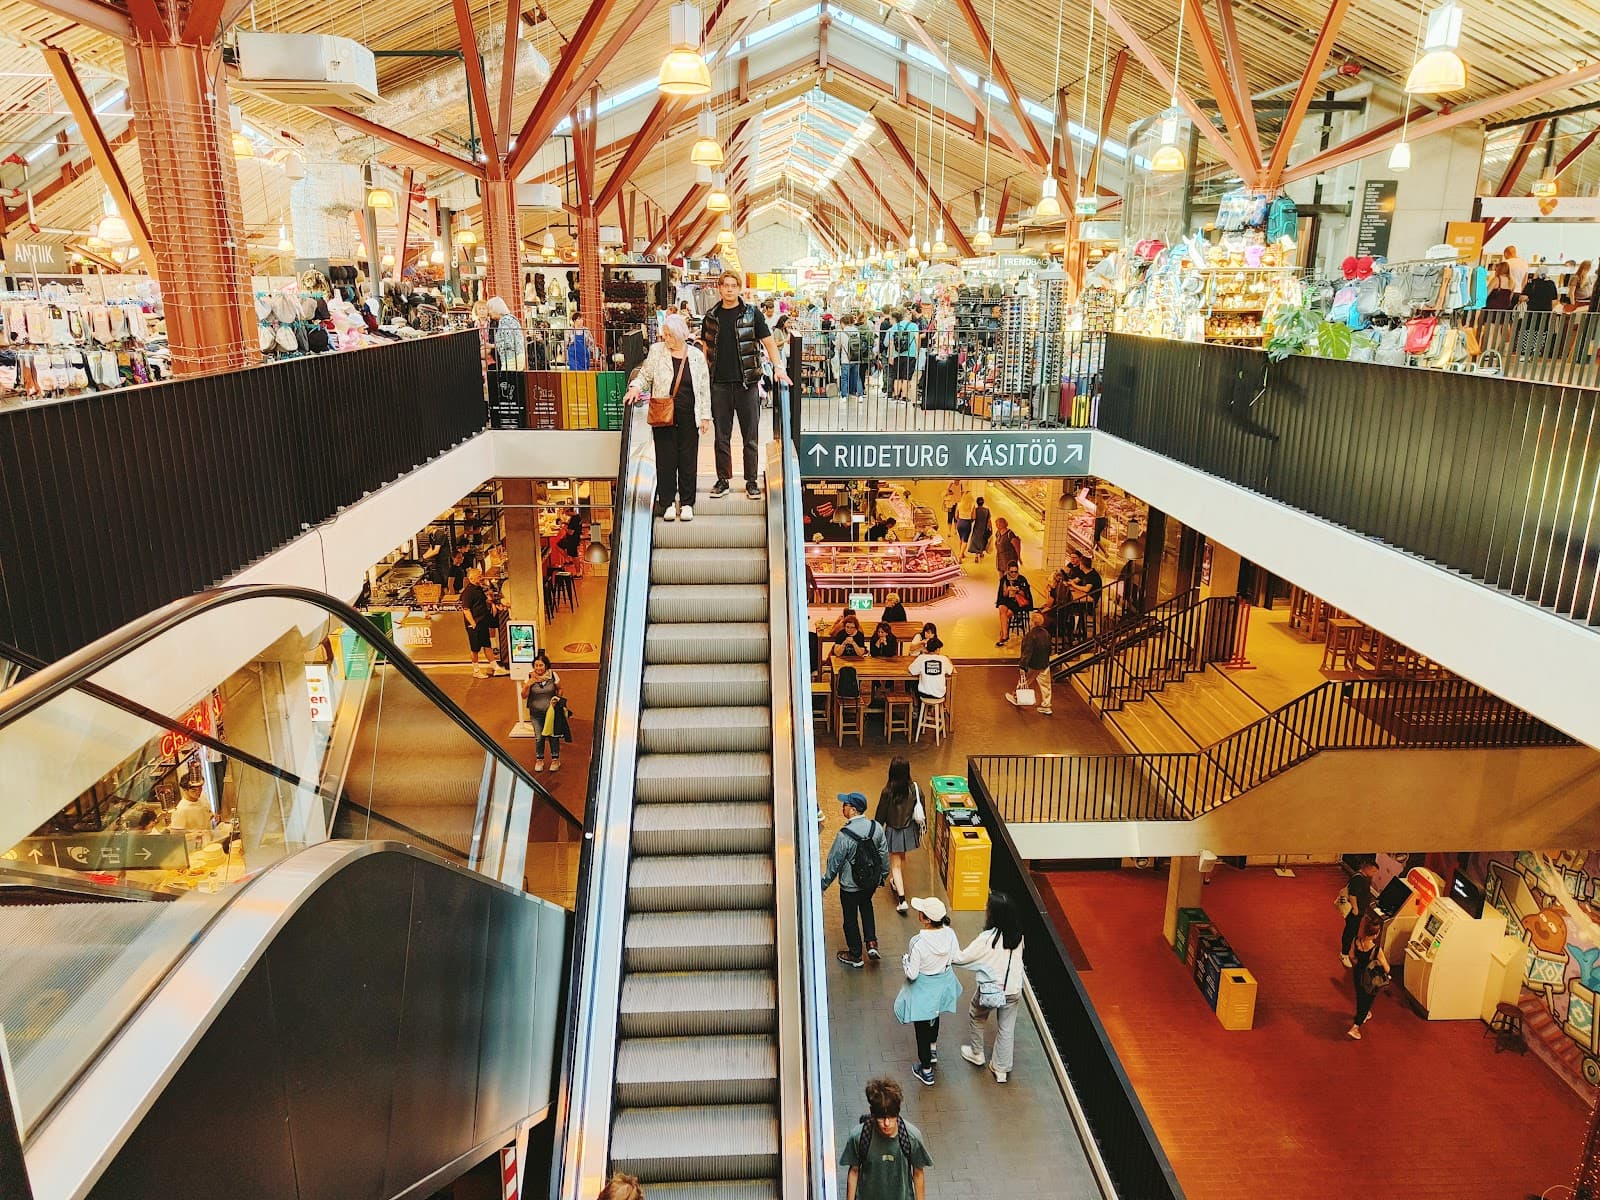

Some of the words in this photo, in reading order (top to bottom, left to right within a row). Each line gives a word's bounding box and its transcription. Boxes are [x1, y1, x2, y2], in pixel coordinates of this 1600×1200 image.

[15, 243, 55, 264] ANTIIK
[835, 444, 949, 468] RIIDETURG
[965, 439, 1057, 467] KÄSITÖÖ
